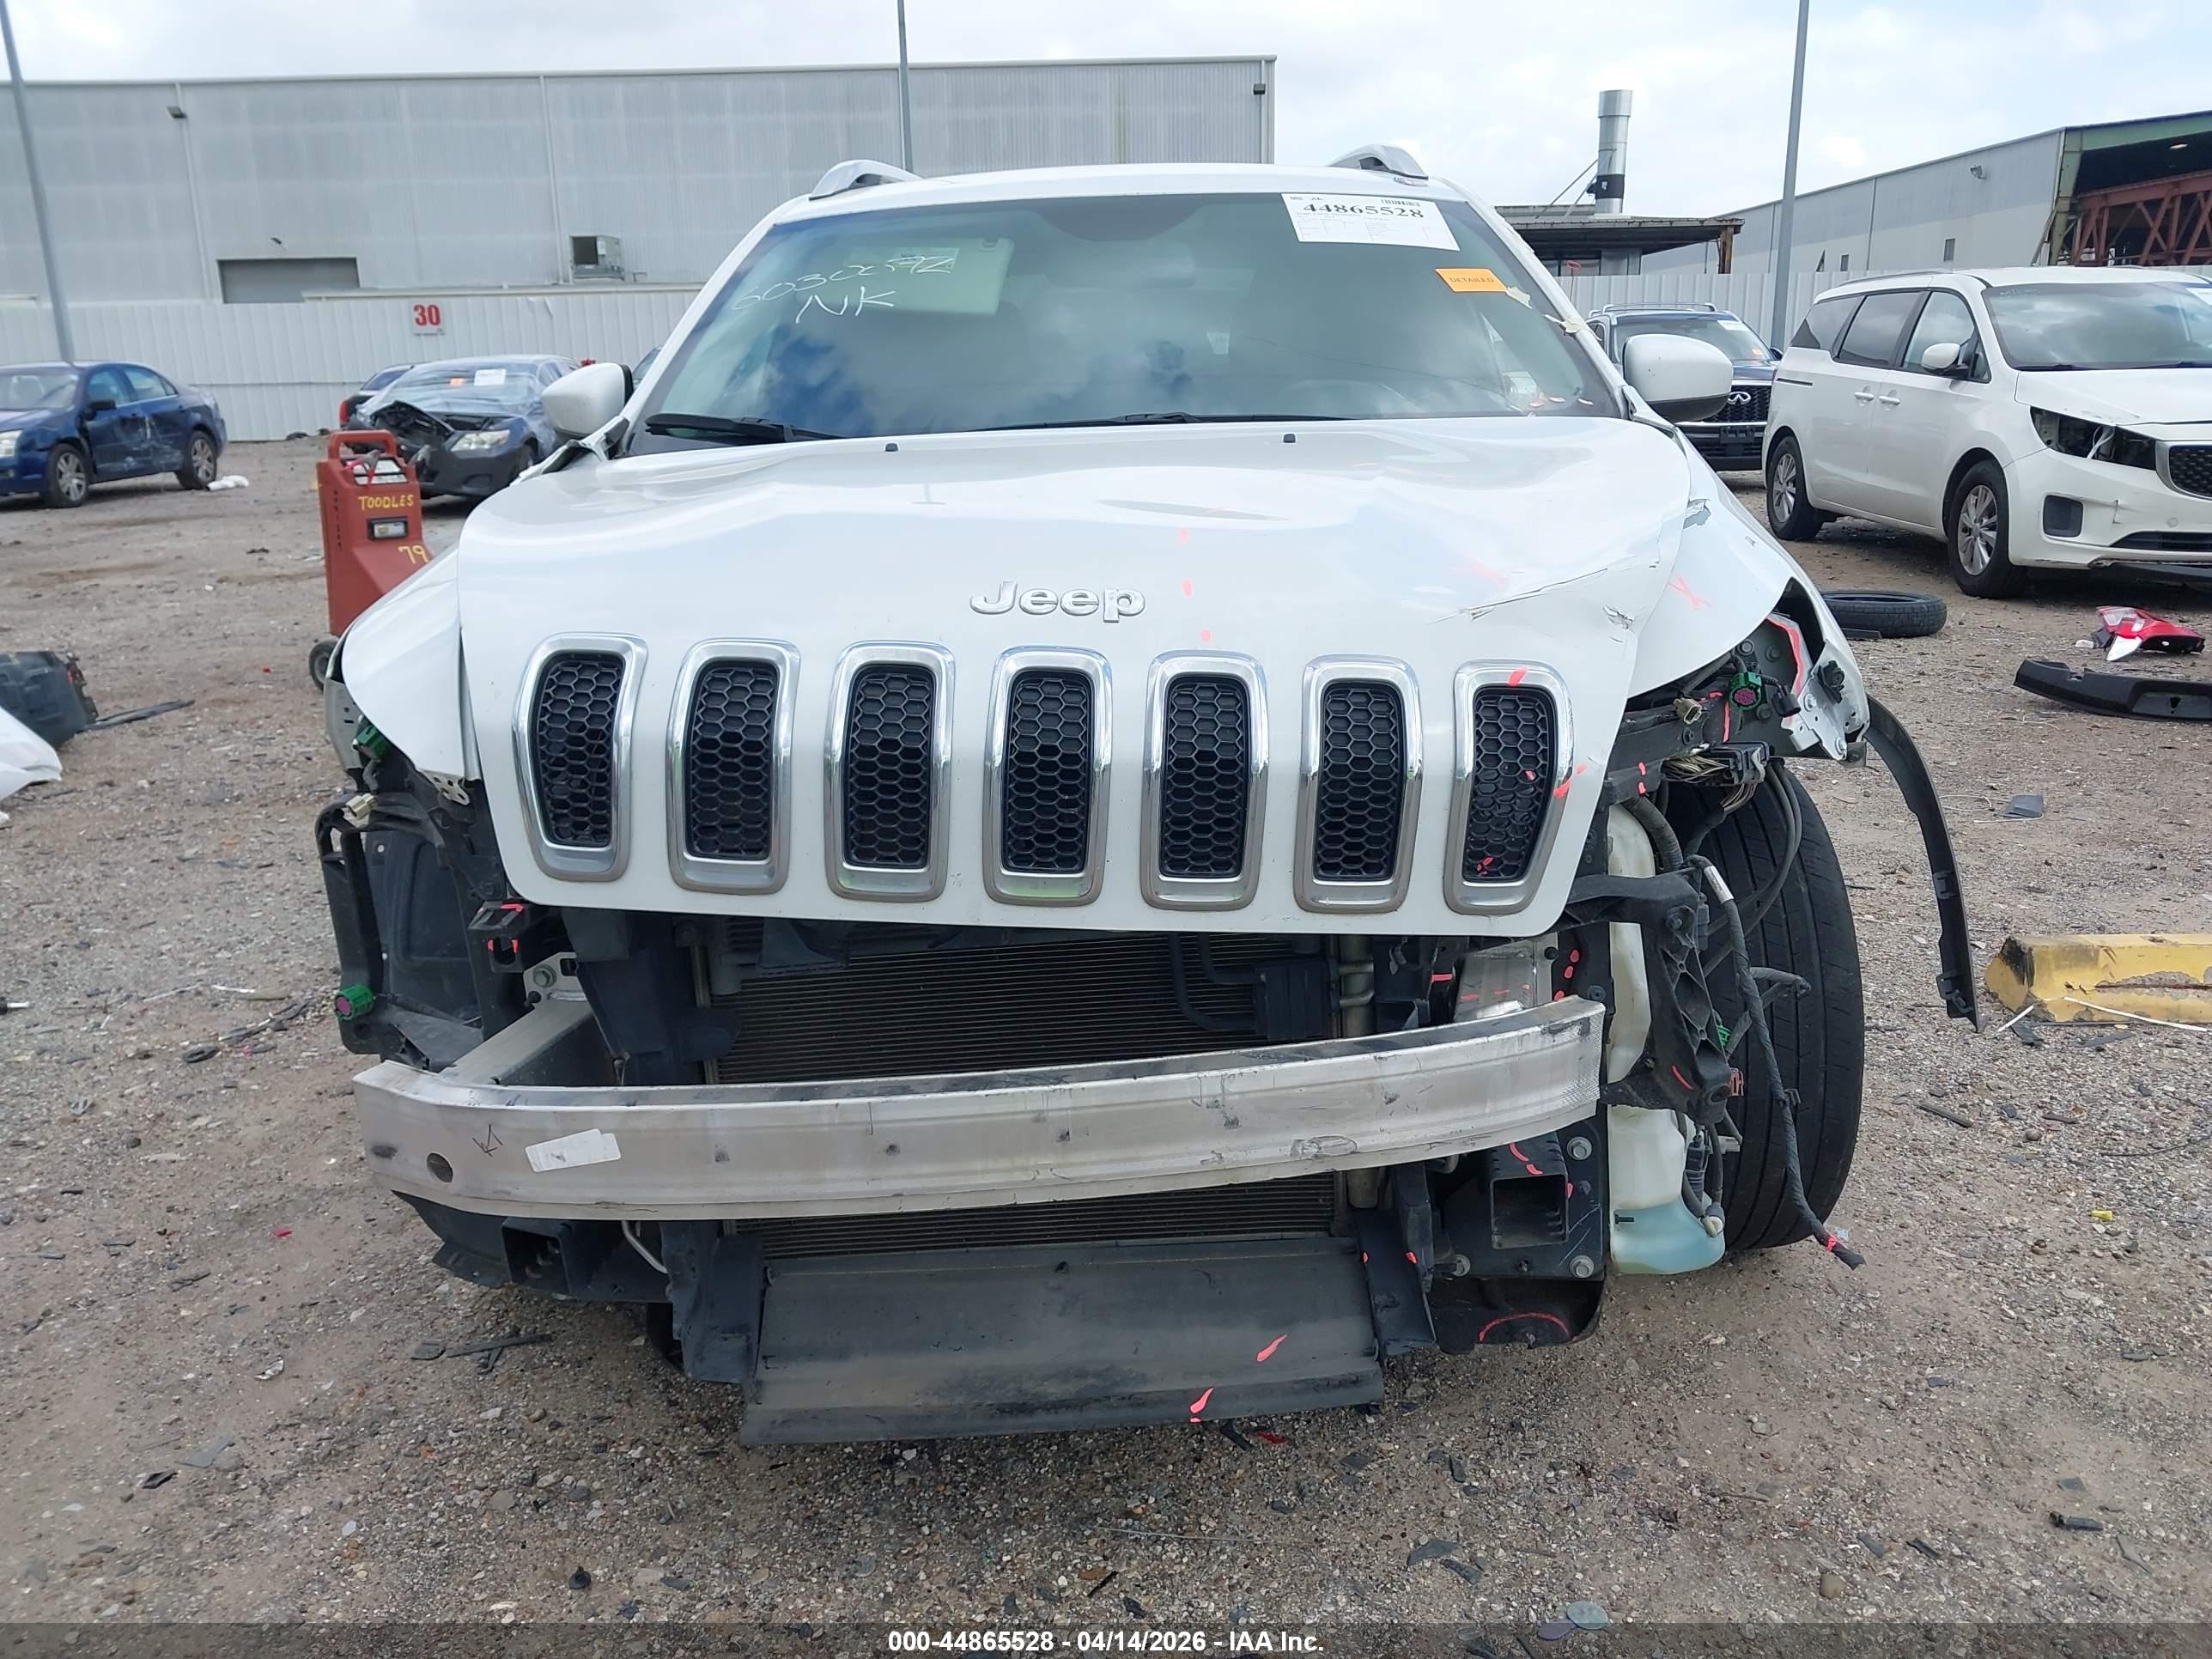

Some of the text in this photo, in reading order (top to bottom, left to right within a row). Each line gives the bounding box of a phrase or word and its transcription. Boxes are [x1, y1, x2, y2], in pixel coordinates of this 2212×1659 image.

[1303, 204, 1425, 218] 44865528
[413, 304, 441, 326] 30
[795, 286, 896, 323] NK
[358, 494, 414, 511] TOODLES
[398, 544, 428, 564] 79
[969, 580, 1146, 623] Jeep
